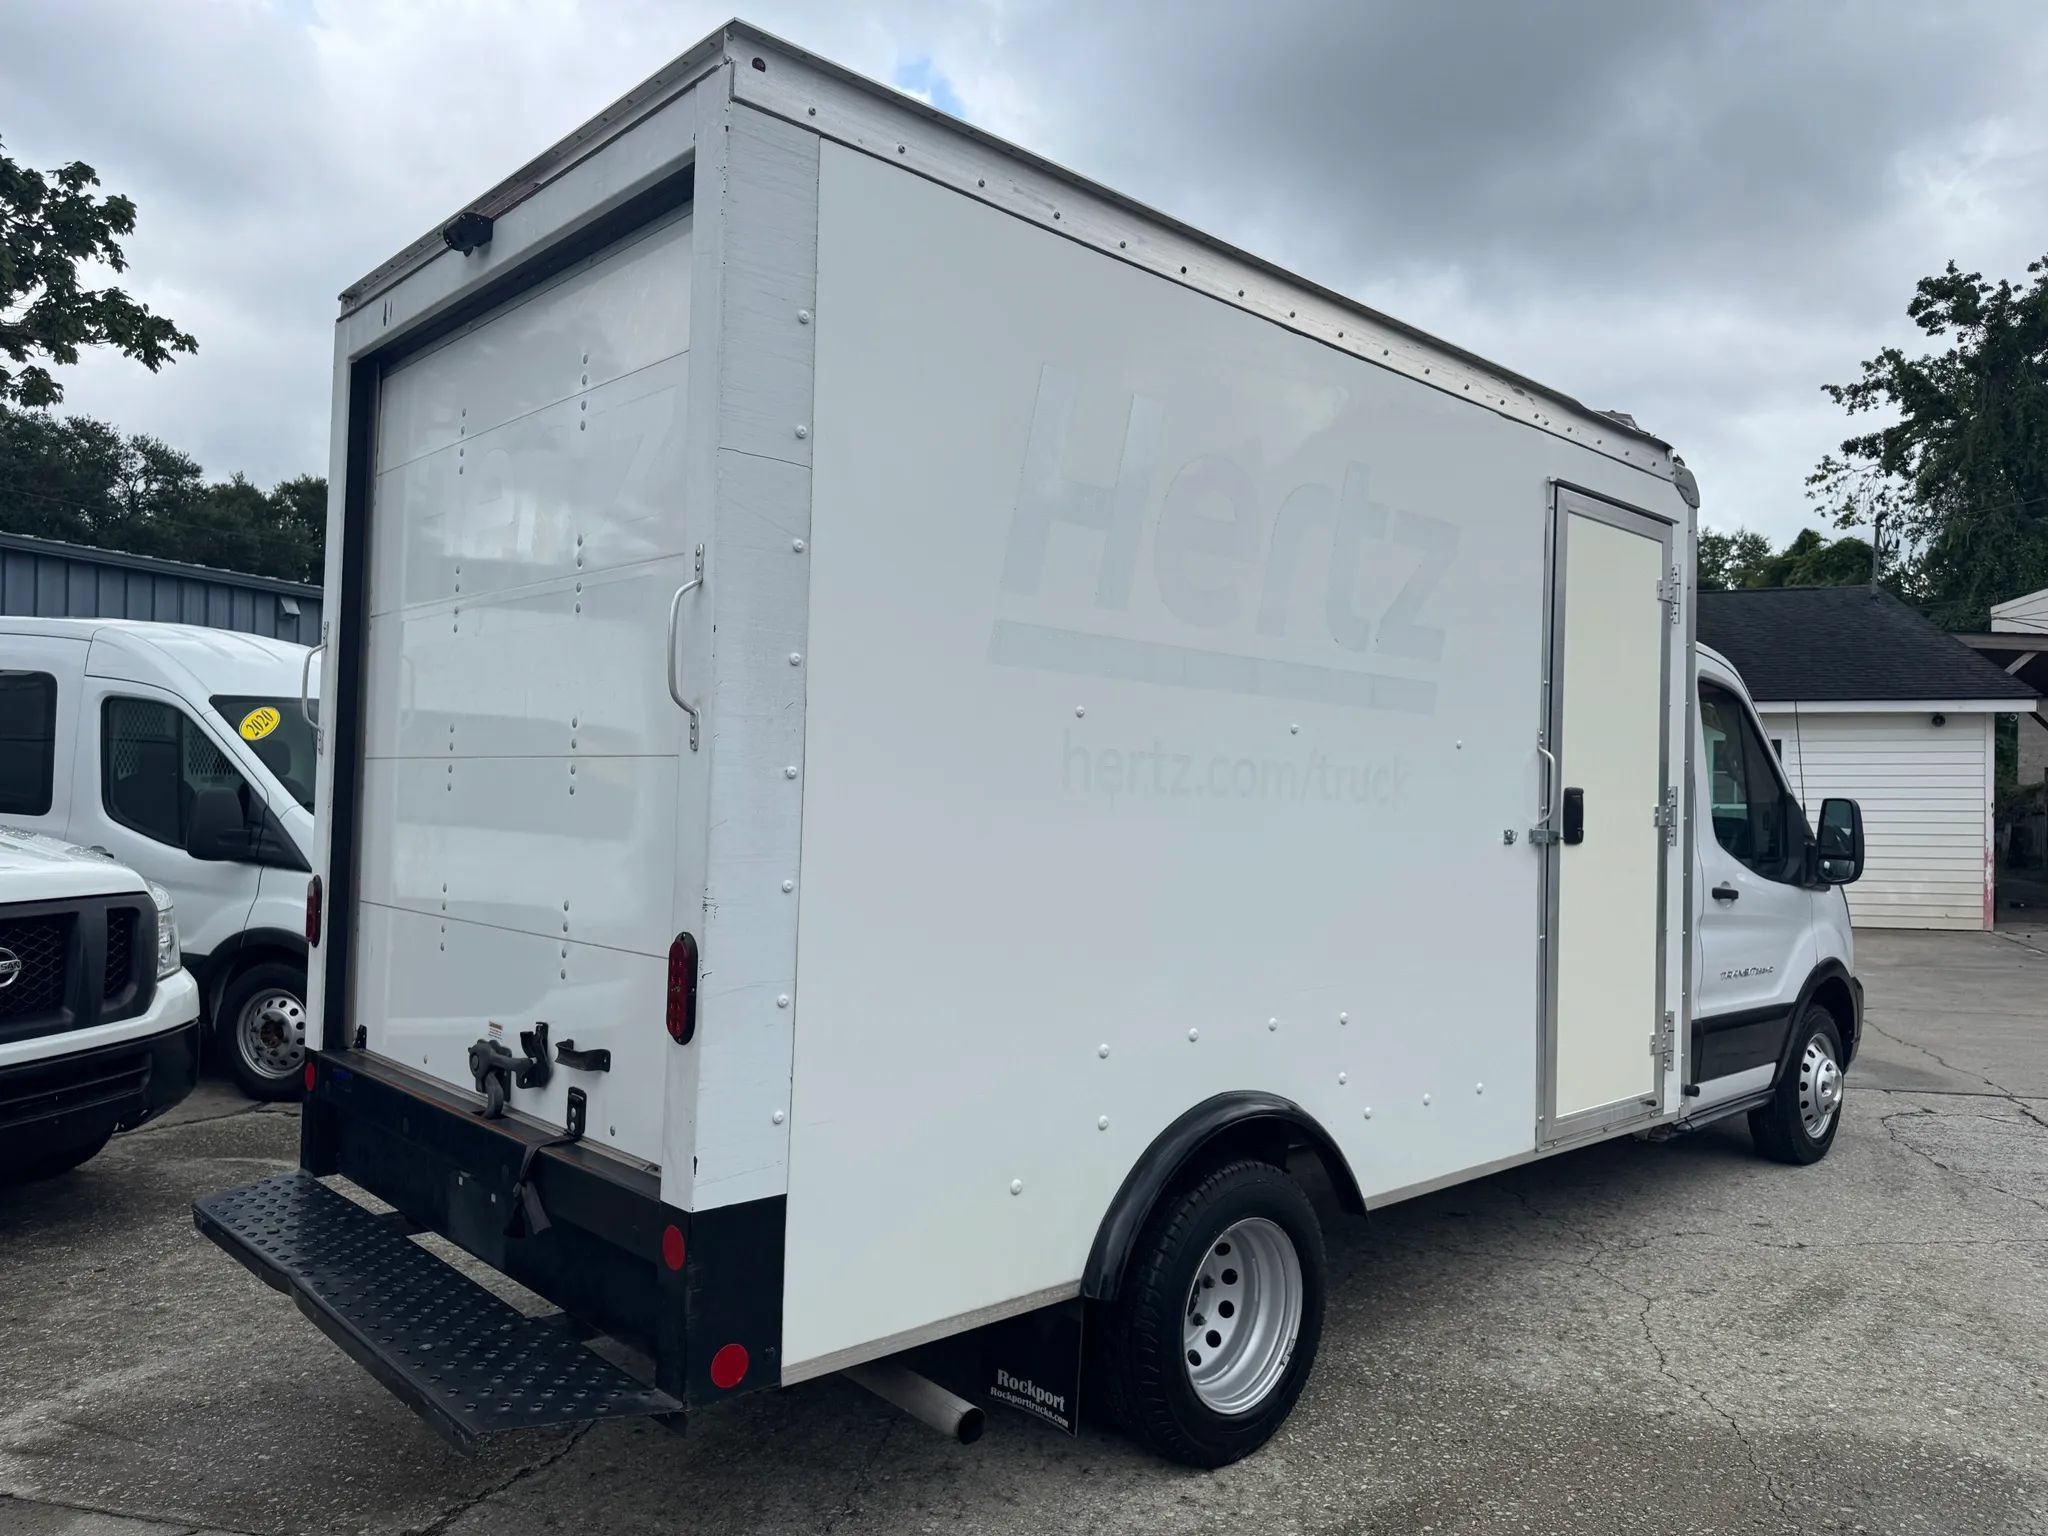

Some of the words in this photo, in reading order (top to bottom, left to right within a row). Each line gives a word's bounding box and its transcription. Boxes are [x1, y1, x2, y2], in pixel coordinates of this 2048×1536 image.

[1001, 361, 1461, 662] Hertz
[247, 710, 274, 736] 2020
[1061, 727, 1409, 807] hertz.com/truck
[997, 1368, 1065, 1412] Rockport
